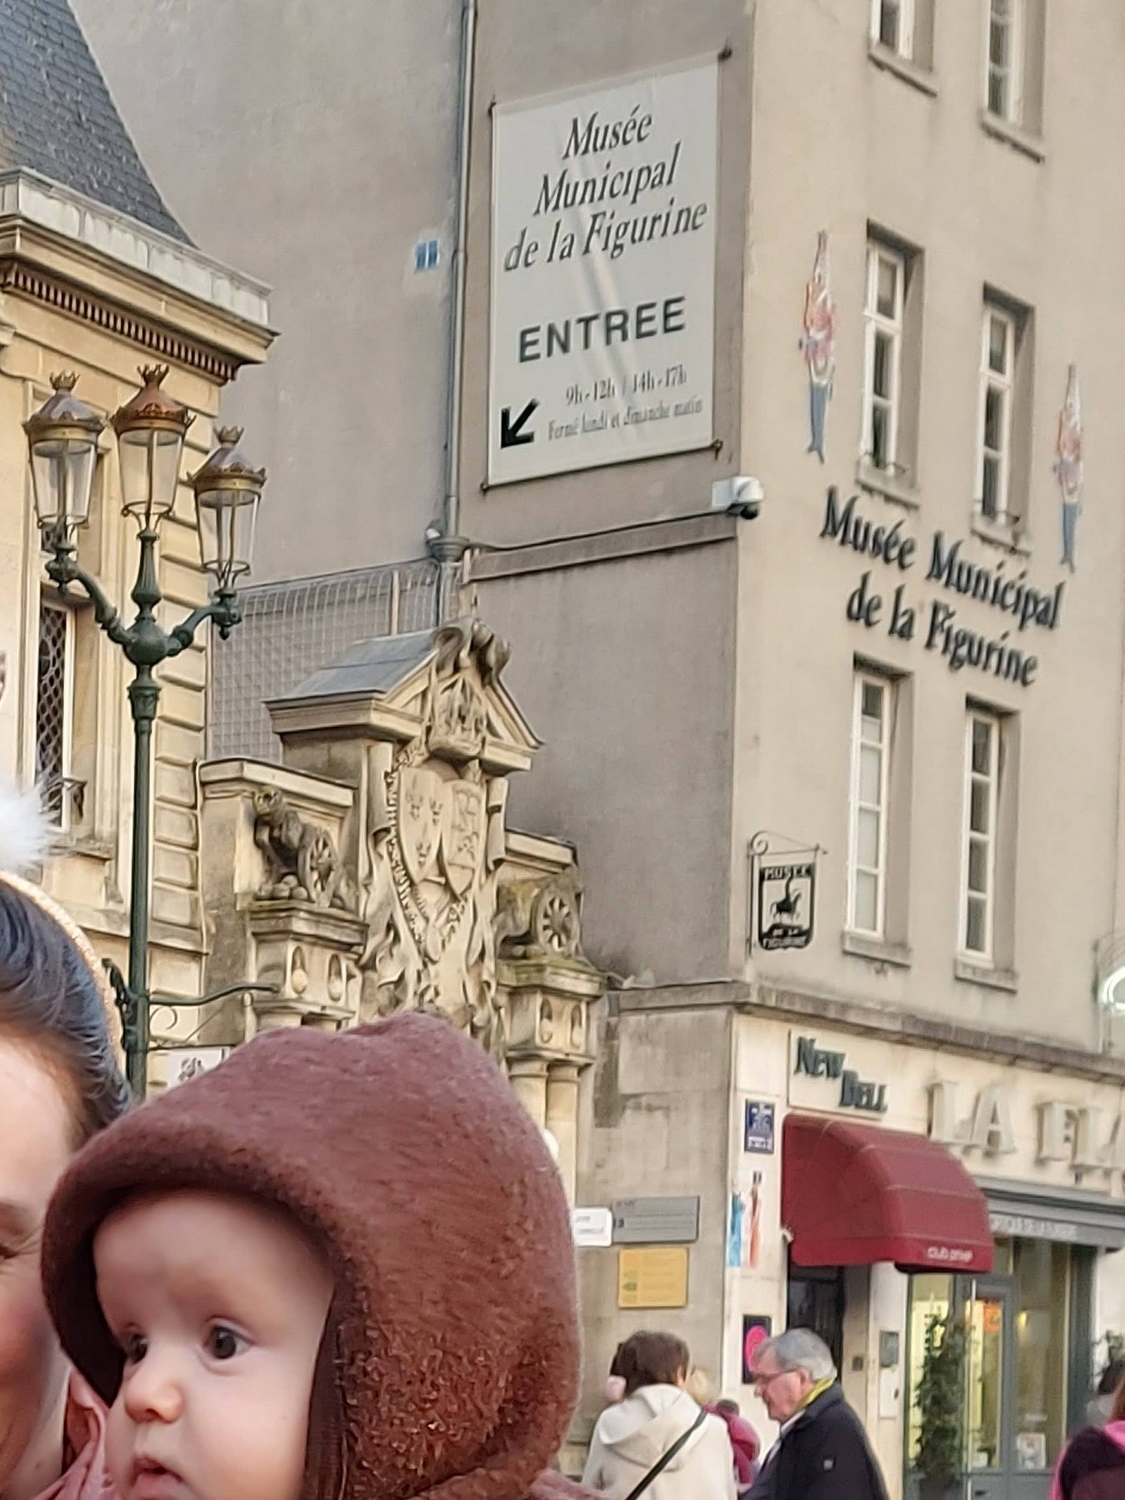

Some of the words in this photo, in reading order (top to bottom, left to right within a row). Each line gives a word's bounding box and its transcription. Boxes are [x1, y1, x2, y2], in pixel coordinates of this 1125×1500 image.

[562, 103, 653, 160] Musée
[532, 140, 682, 217] Municipal
[503, 225, 540, 272] de
[546, 218, 576, 264] la
[581, 196, 708, 260] Figurine
[518, 295, 686, 363] ENTREE
[818, 484, 916, 571] Musée
[924, 529, 1067, 632] Municipal
[846, 569, 883, 629] de
[887, 583, 916, 641] la
[923, 597, 1039, 688] Figurine
